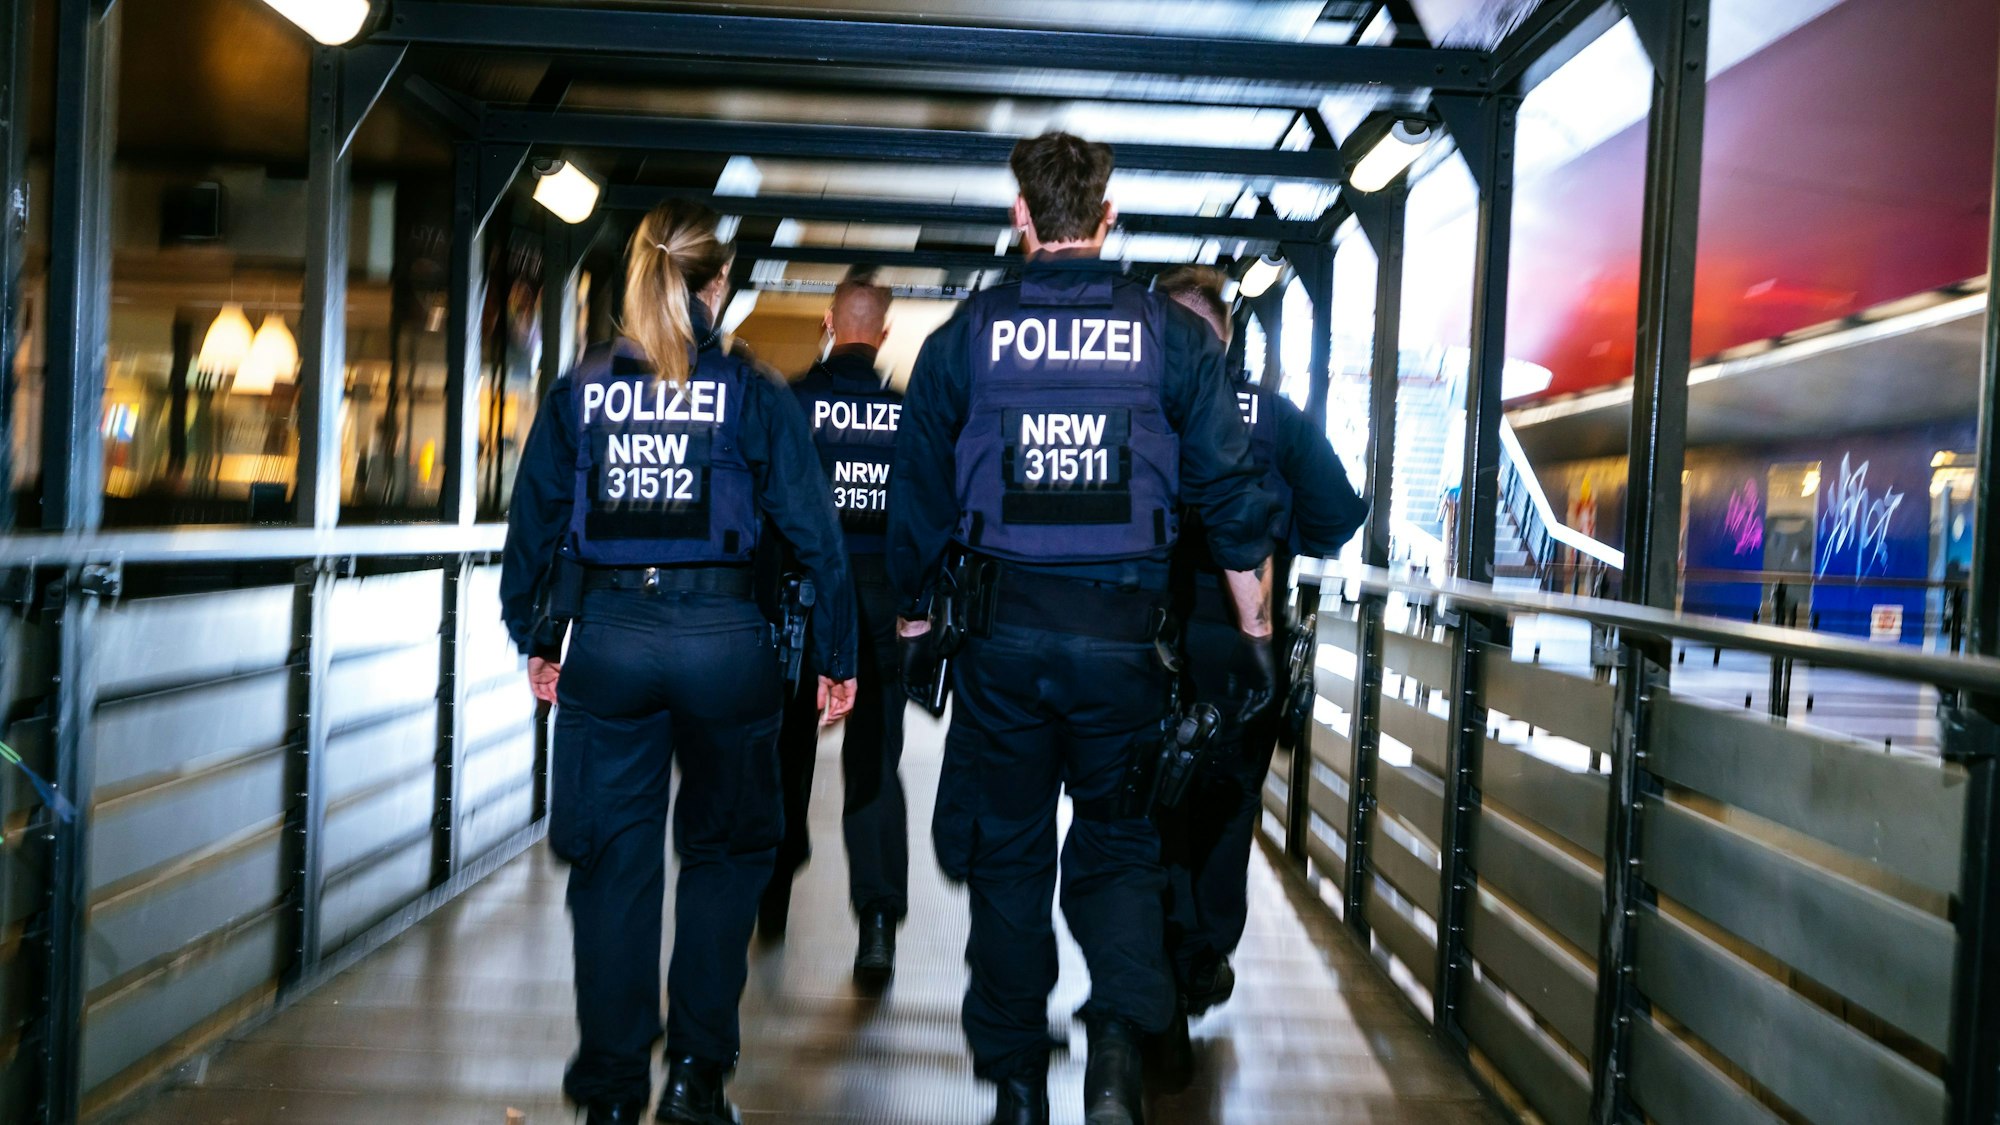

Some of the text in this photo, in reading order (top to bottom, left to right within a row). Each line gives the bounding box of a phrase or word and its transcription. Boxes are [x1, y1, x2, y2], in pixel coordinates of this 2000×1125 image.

[992, 318, 1141, 362] POLIZEI
[584, 380, 726, 423] POLIZEI
[1022, 414, 1106, 445] NRW
[608, 434, 689, 464] NRW
[1025, 448, 1107, 481] 31511
[608, 467, 693, 499] 31512
[835, 461, 890, 484] NRW
